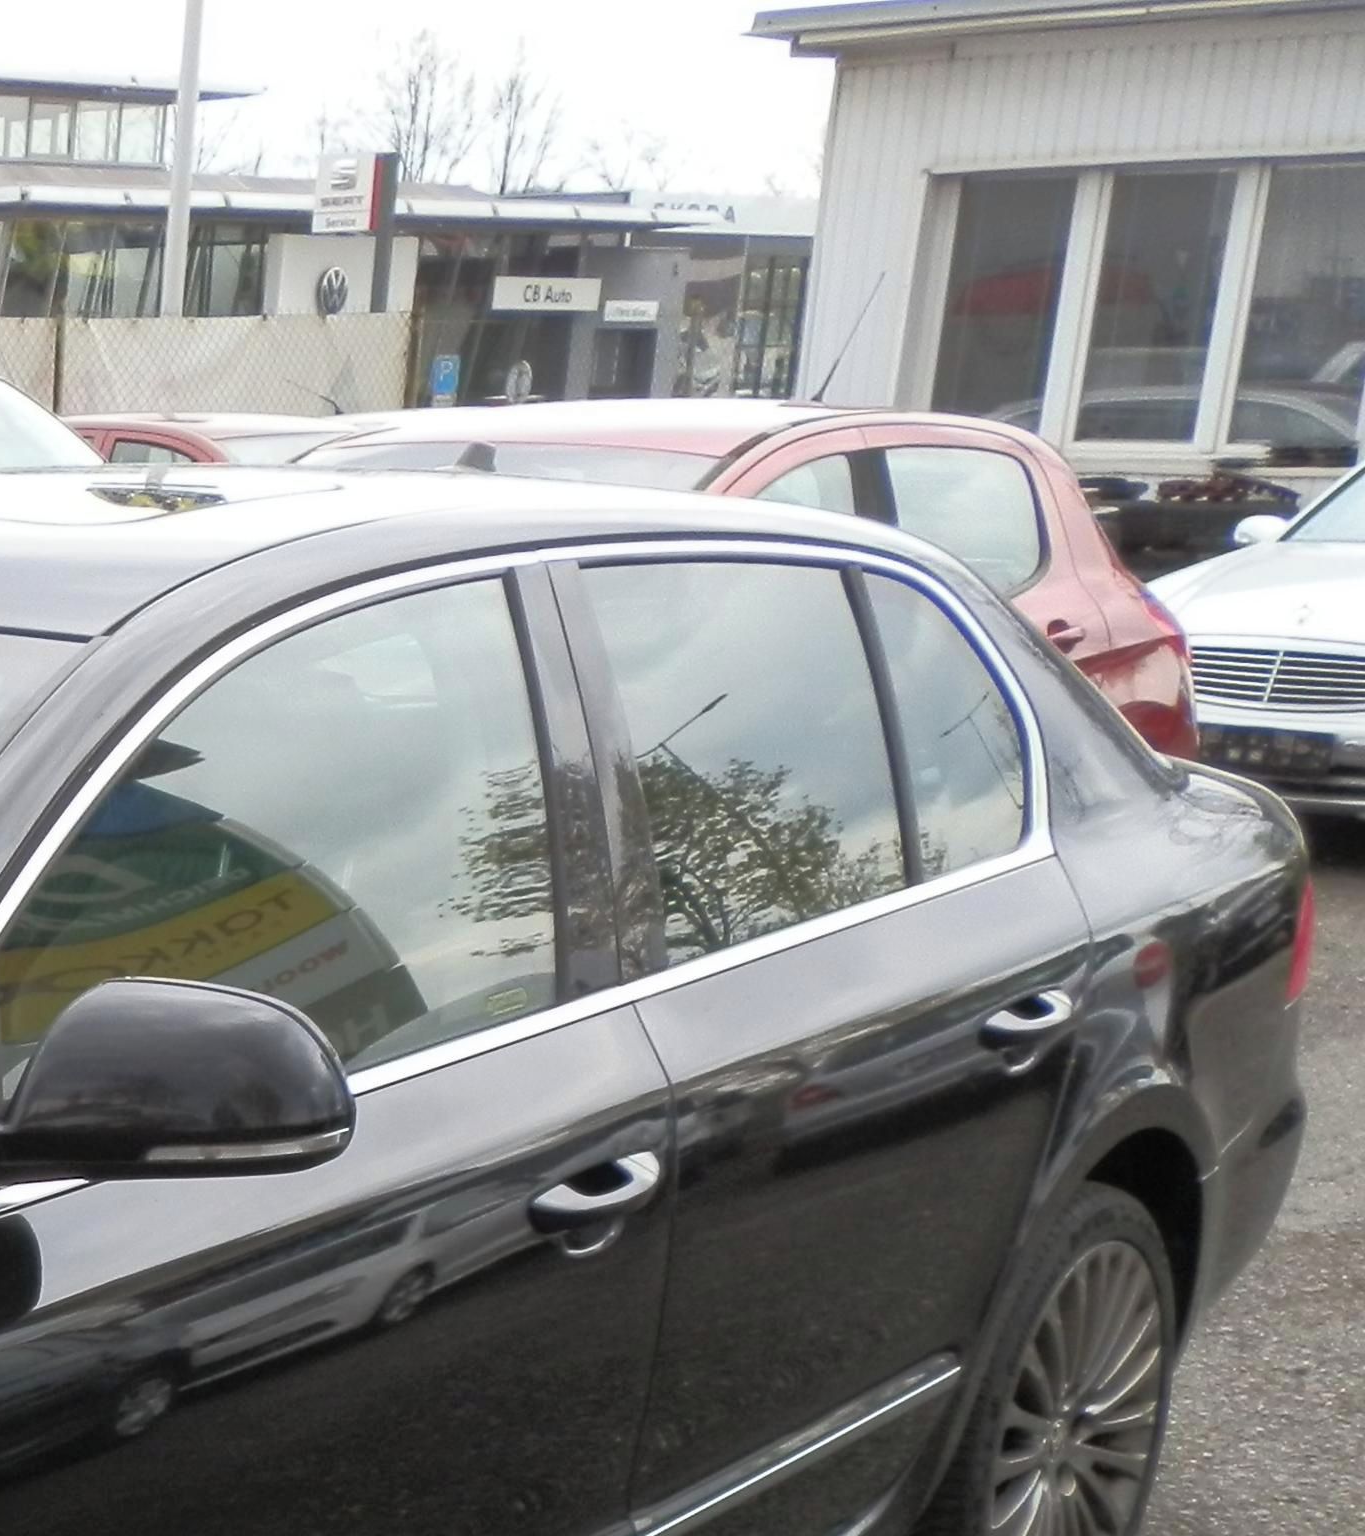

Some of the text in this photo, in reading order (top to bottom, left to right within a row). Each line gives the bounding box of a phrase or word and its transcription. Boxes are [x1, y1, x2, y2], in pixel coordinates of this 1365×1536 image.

[522, 284, 572, 303] CB Auto
[440, 361, 453, 381] P
